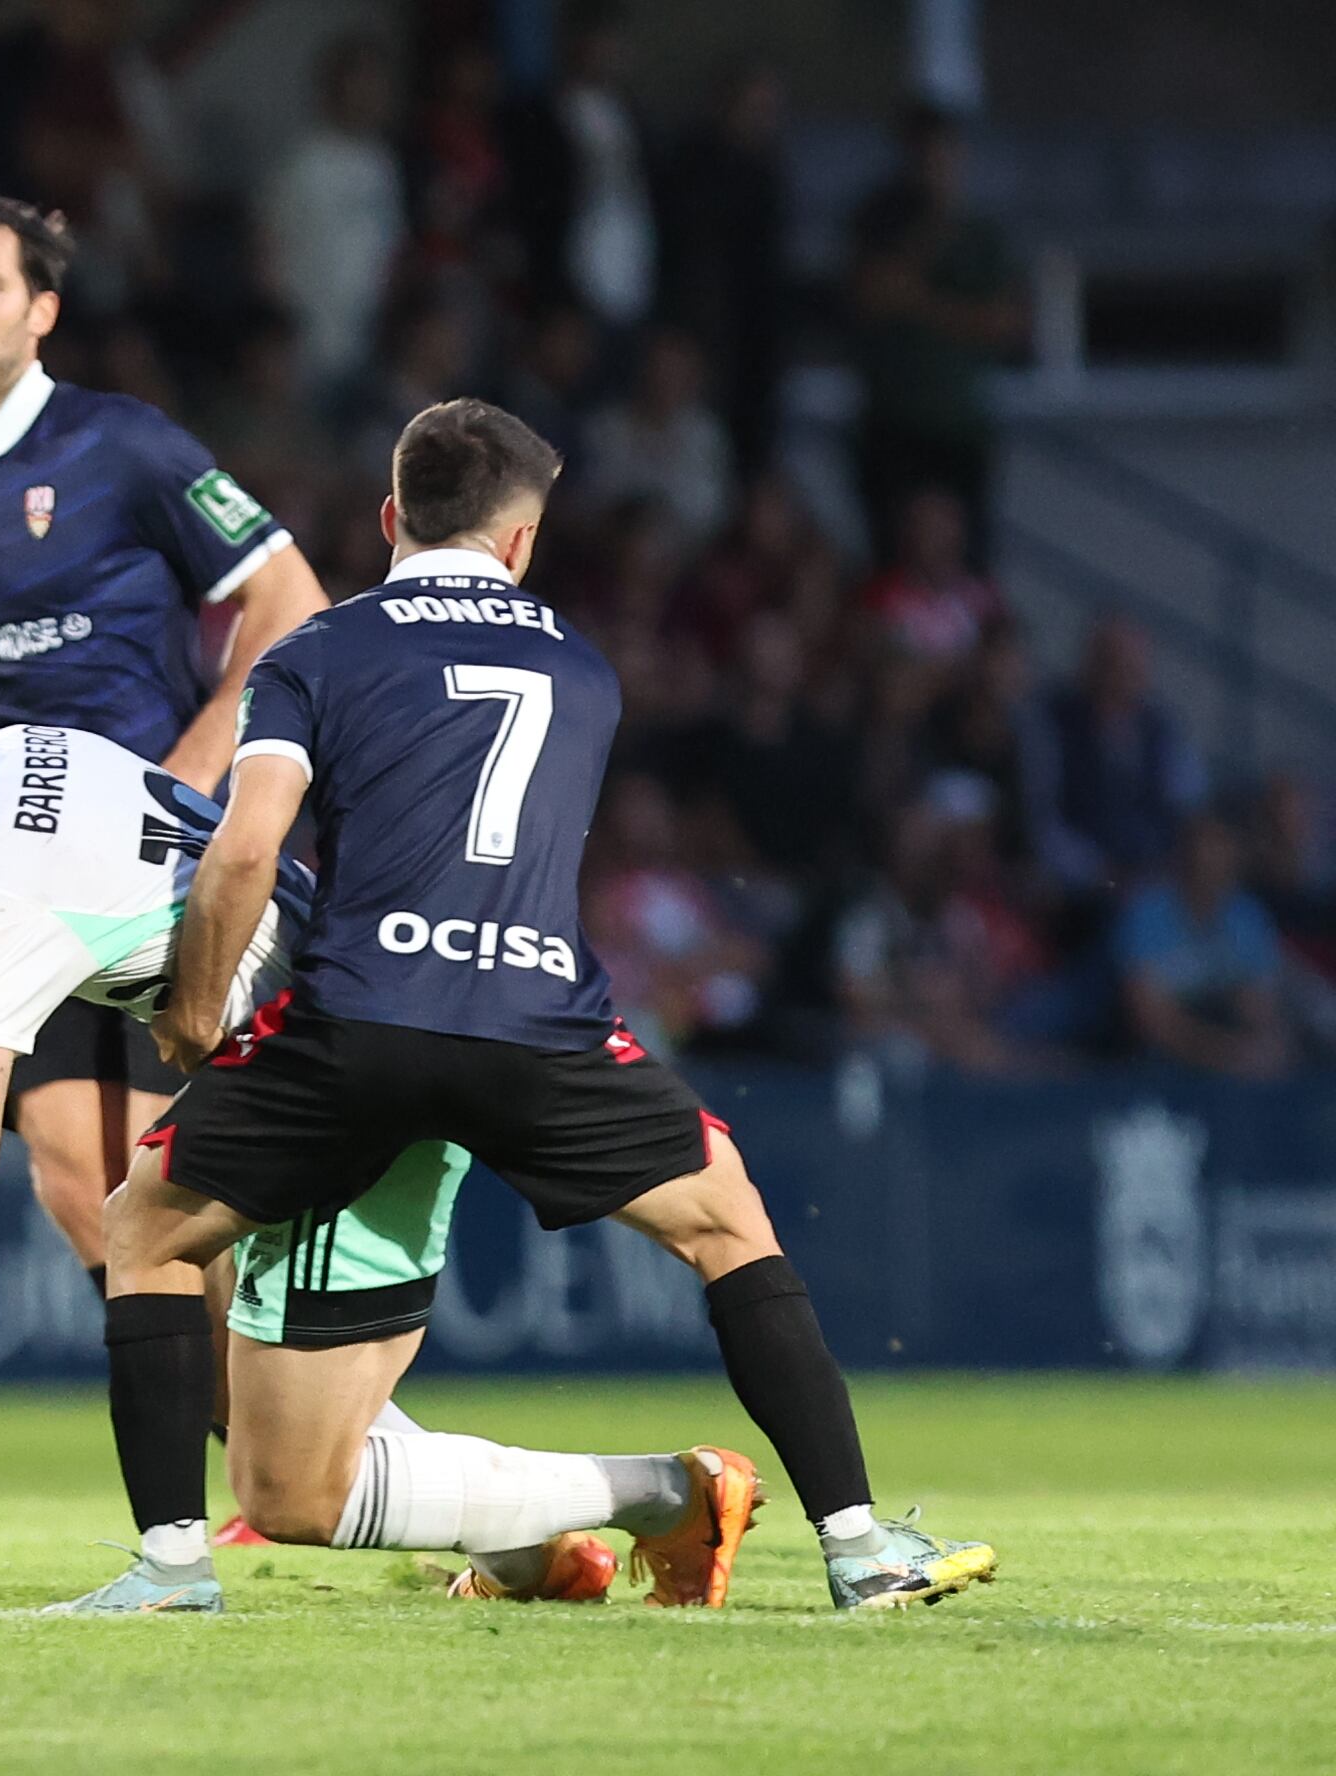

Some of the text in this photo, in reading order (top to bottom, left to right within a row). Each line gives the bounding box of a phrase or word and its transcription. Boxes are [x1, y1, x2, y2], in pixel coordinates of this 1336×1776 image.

[380, 597, 564, 641] DONCEL
[14, 725, 68, 834] BARBERO
[442, 664, 554, 866] 7
